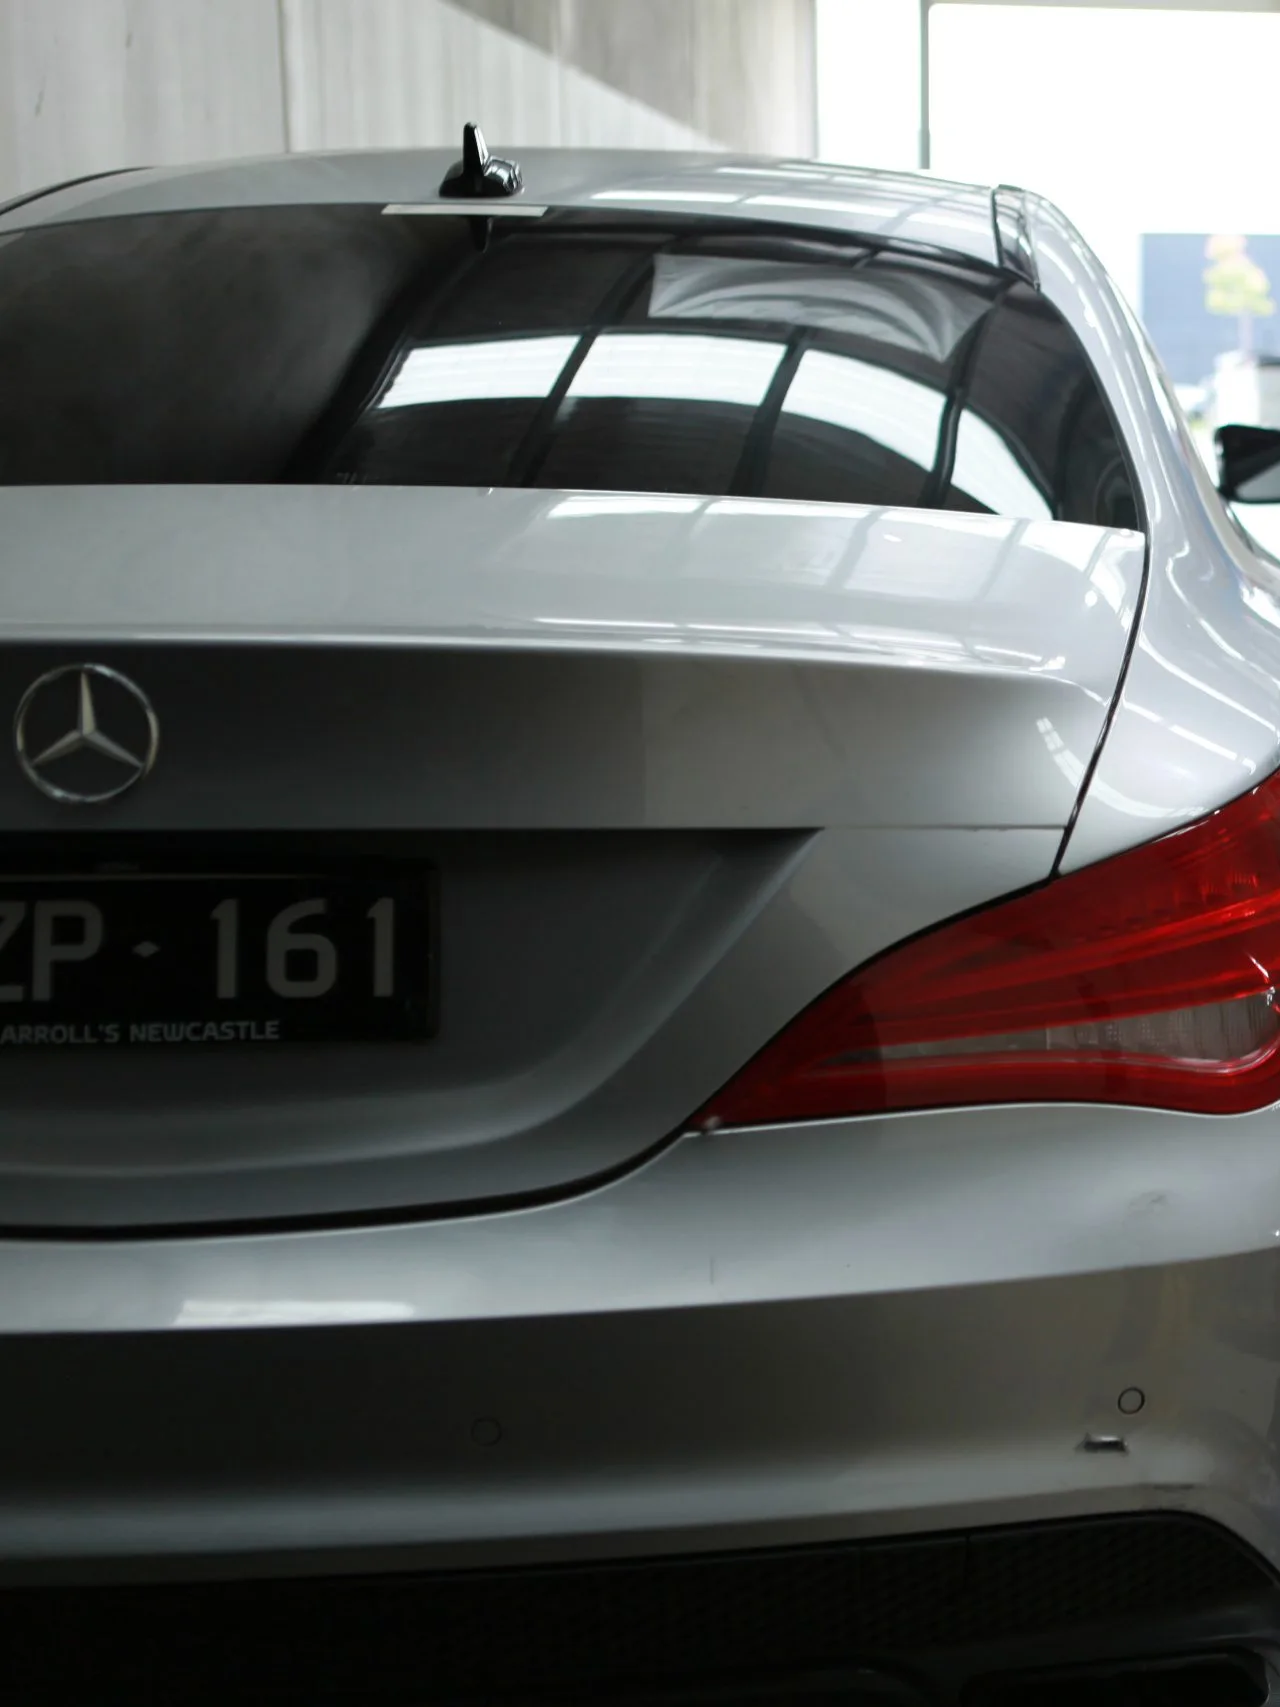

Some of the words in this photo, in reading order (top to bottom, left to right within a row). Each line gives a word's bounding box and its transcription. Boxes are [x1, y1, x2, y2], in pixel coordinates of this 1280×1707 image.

[210, 898, 395, 999] 161
[0, 1024, 120, 1044] ARROLL'S
[130, 1020, 280, 1042] NEWCASTLE
